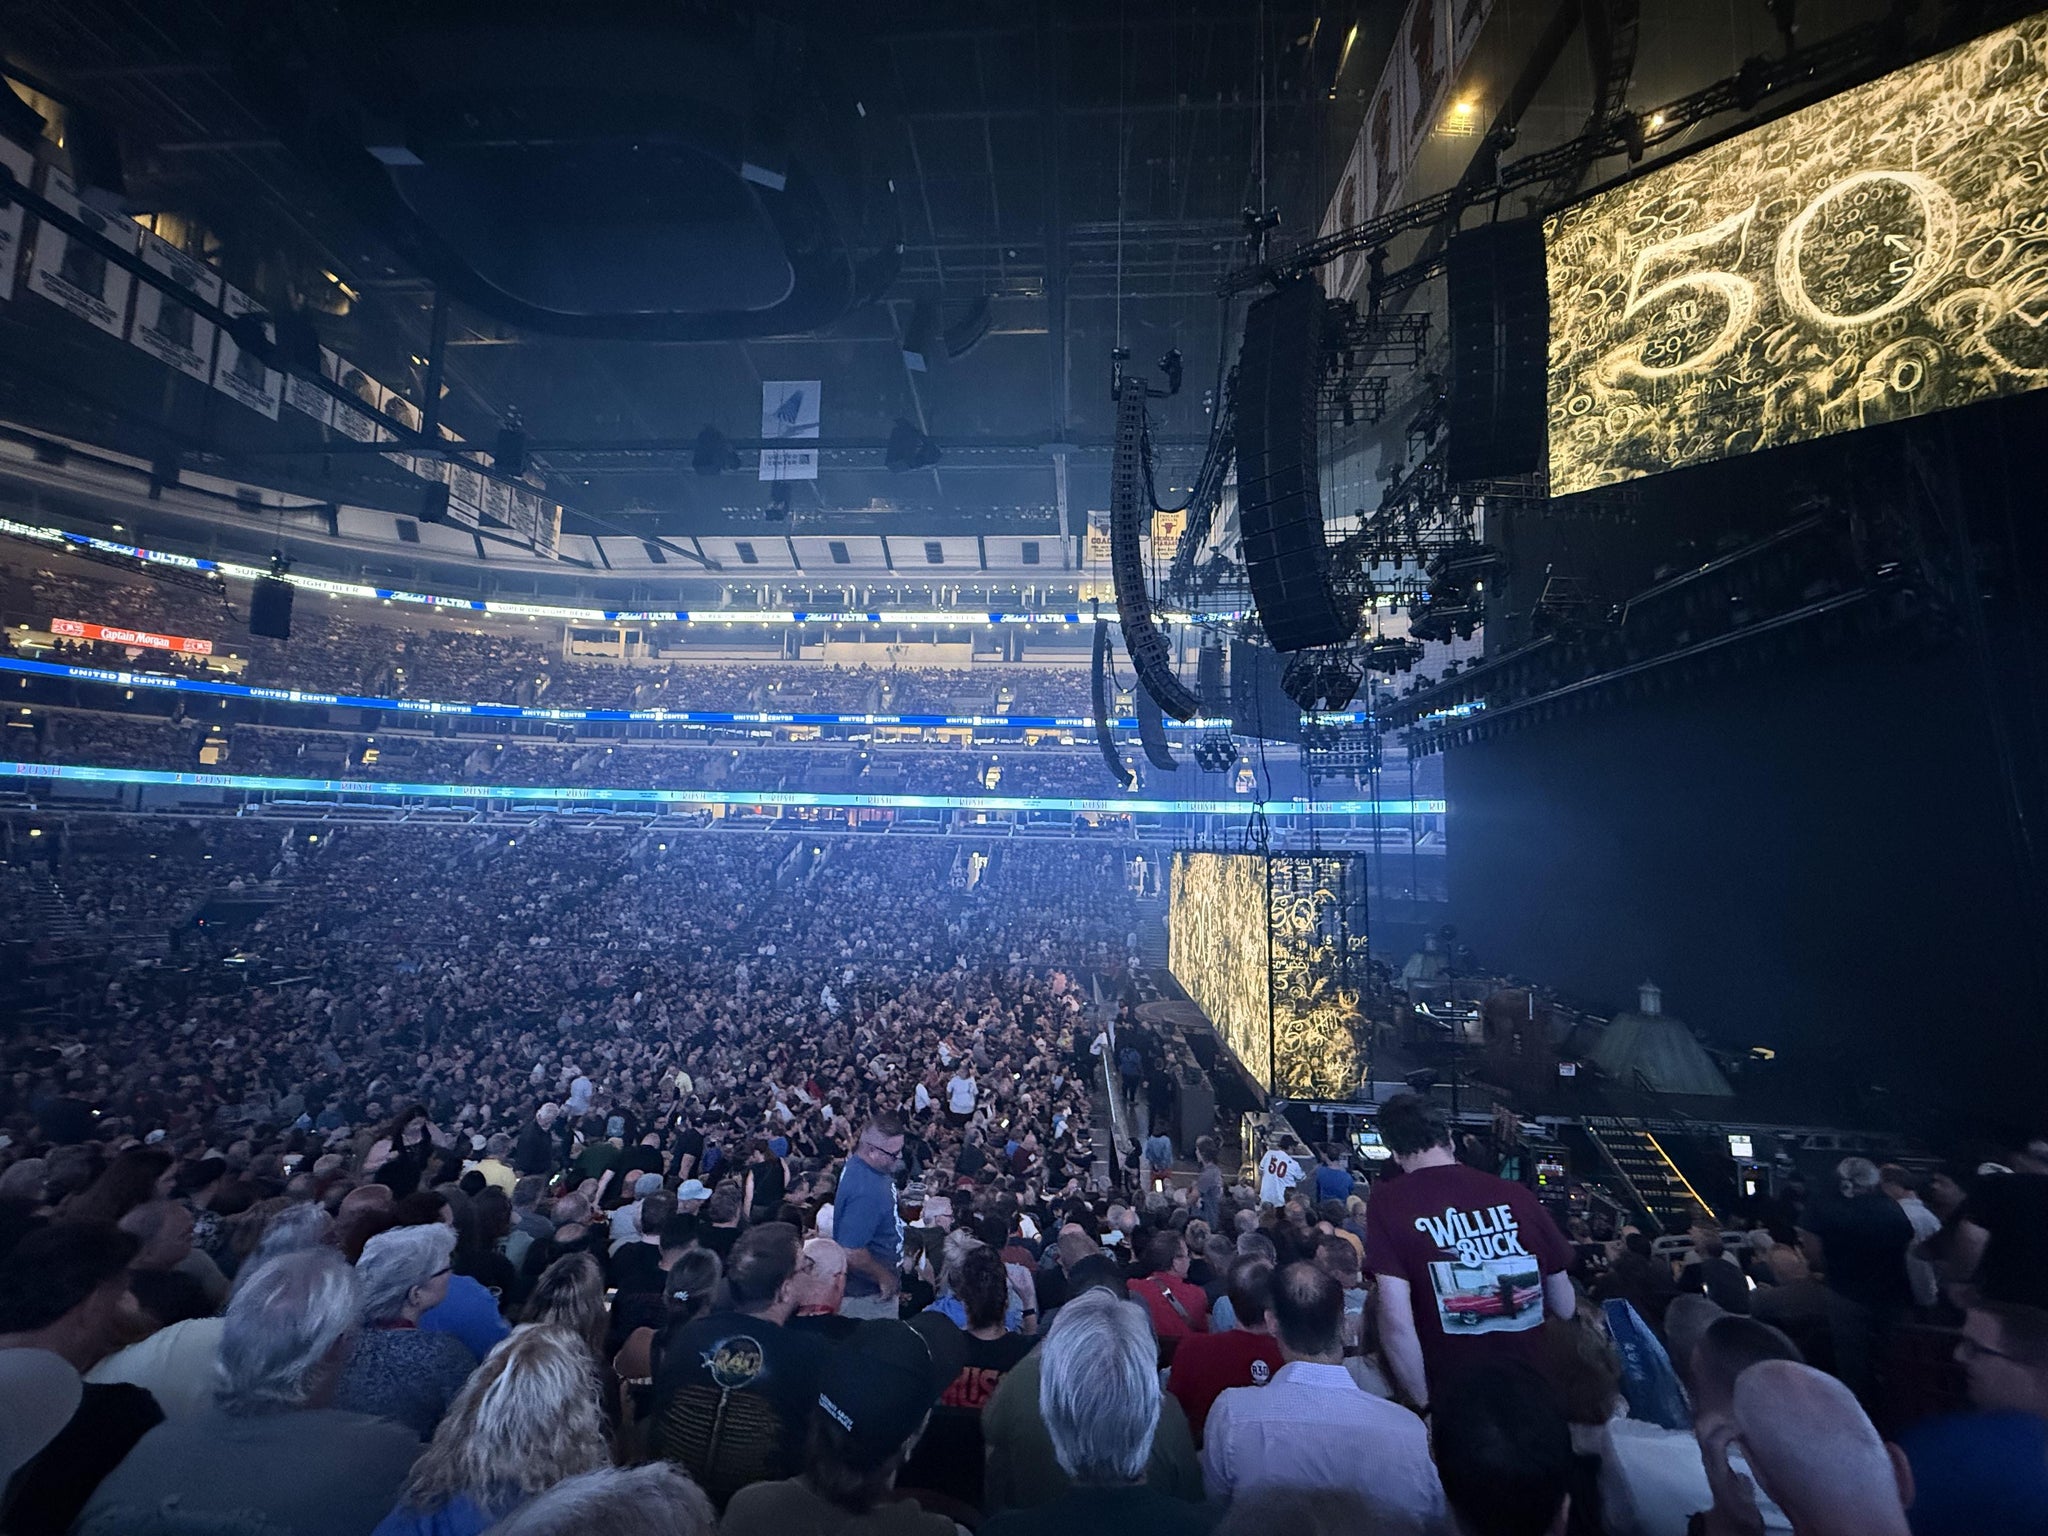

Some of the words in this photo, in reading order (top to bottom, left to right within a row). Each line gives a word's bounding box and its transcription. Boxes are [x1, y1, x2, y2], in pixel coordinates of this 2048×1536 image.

[1598, 169, 1958, 378] 50
[149, 550, 199, 568] ULTRA
[435, 596, 473, 609] ULTRA
[1036, 613, 1067, 623] ULTRA
[101, 627, 135, 641] Captain
[135, 631, 170, 648] Morgan
[69, 668, 117, 680] UNITED
[132, 675, 177, 688] CENTER
[250, 688, 289, 699] UNITED
[301, 693, 338, 703] CENTER
[397, 702, 431, 711] UNITED
[441, 705, 472, 714] CENTER
[522, 709, 551, 718] UNITED
[560, 711, 587, 719] CENTER
[629, 712, 656, 720] UNITED
[838, 715, 865, 723] UNITED
[1055, 718, 1083, 726] UNITED
[15, 763, 62, 776] RUSH
[194, 775, 233, 786] RUSH
[340, 781, 372, 792] RUSH
[462, 786, 491, 797] RUSH
[1268, 1155, 1288, 1178] 50
[1414, 1204, 1519, 1248] WILLIE
[1456, 1230, 1529, 1268] BUCK
